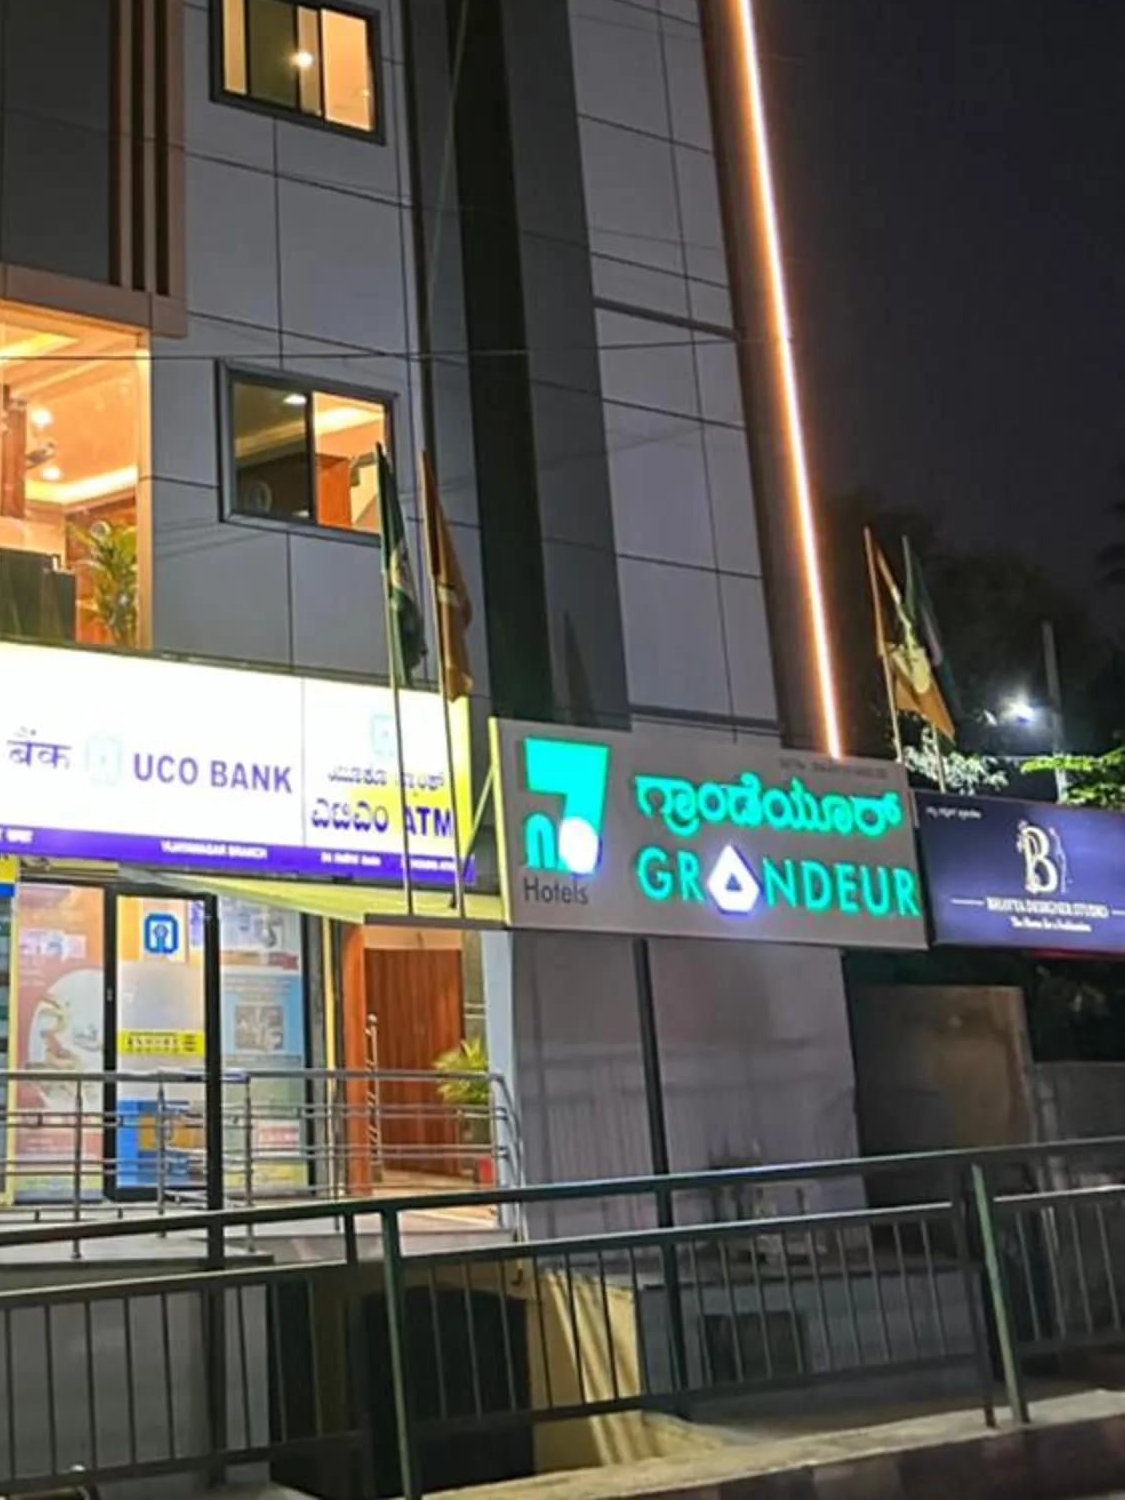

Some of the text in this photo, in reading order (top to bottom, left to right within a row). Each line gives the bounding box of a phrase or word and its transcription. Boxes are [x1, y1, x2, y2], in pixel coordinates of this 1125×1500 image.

[5, 726, 73, 770] बैंक
[133, 752, 293, 795] UCO BANK
[402, 804, 453, 837] ATM
[522, 874, 589, 907] Hotels
[635, 844, 922, 918] GRANDEUR
